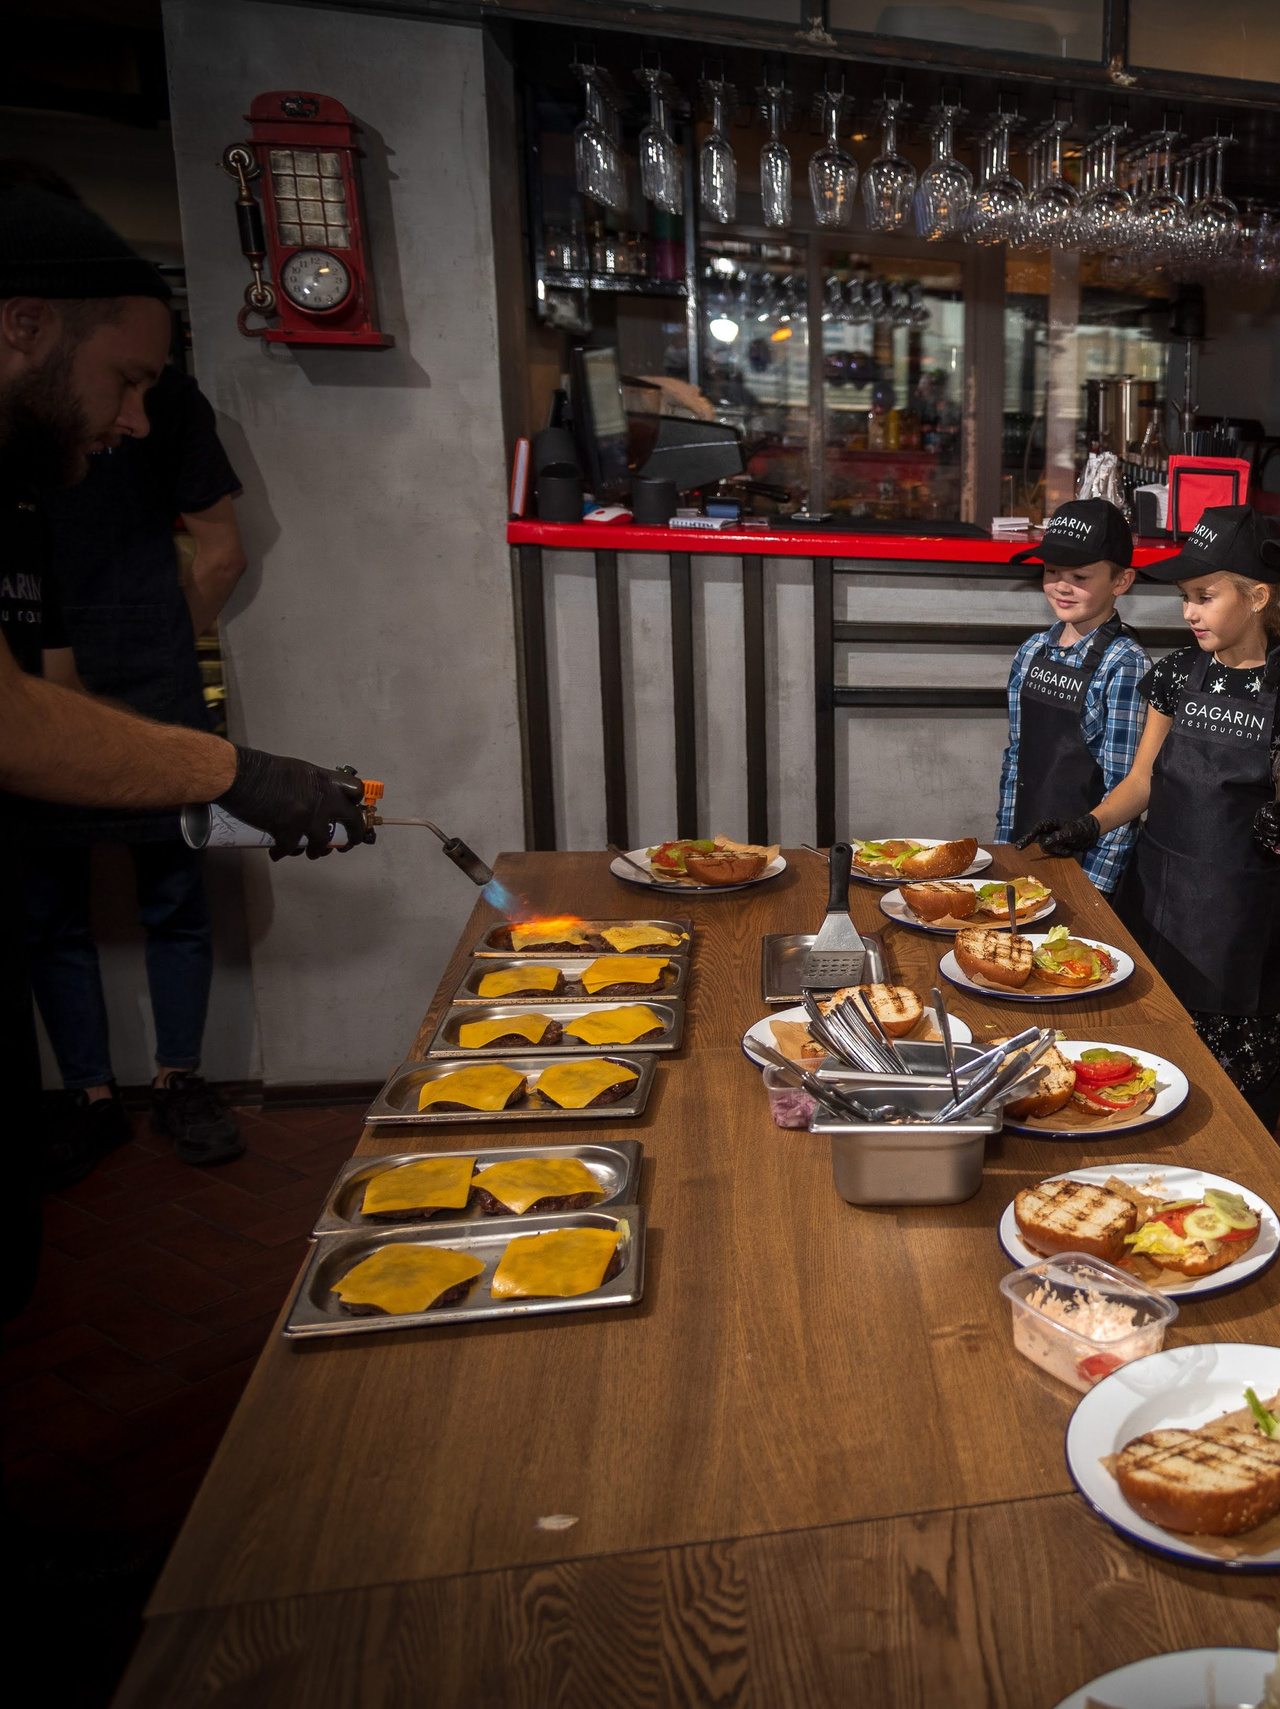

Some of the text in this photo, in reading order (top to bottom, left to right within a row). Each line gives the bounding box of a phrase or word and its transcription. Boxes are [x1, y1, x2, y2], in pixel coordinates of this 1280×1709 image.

[1026, 681, 1077, 702] restaurant
[1030, 666, 1083, 693] GAGARIN
[1185, 701, 1265, 730] GAGARIN
[1181, 719, 1260, 741] restaurant
